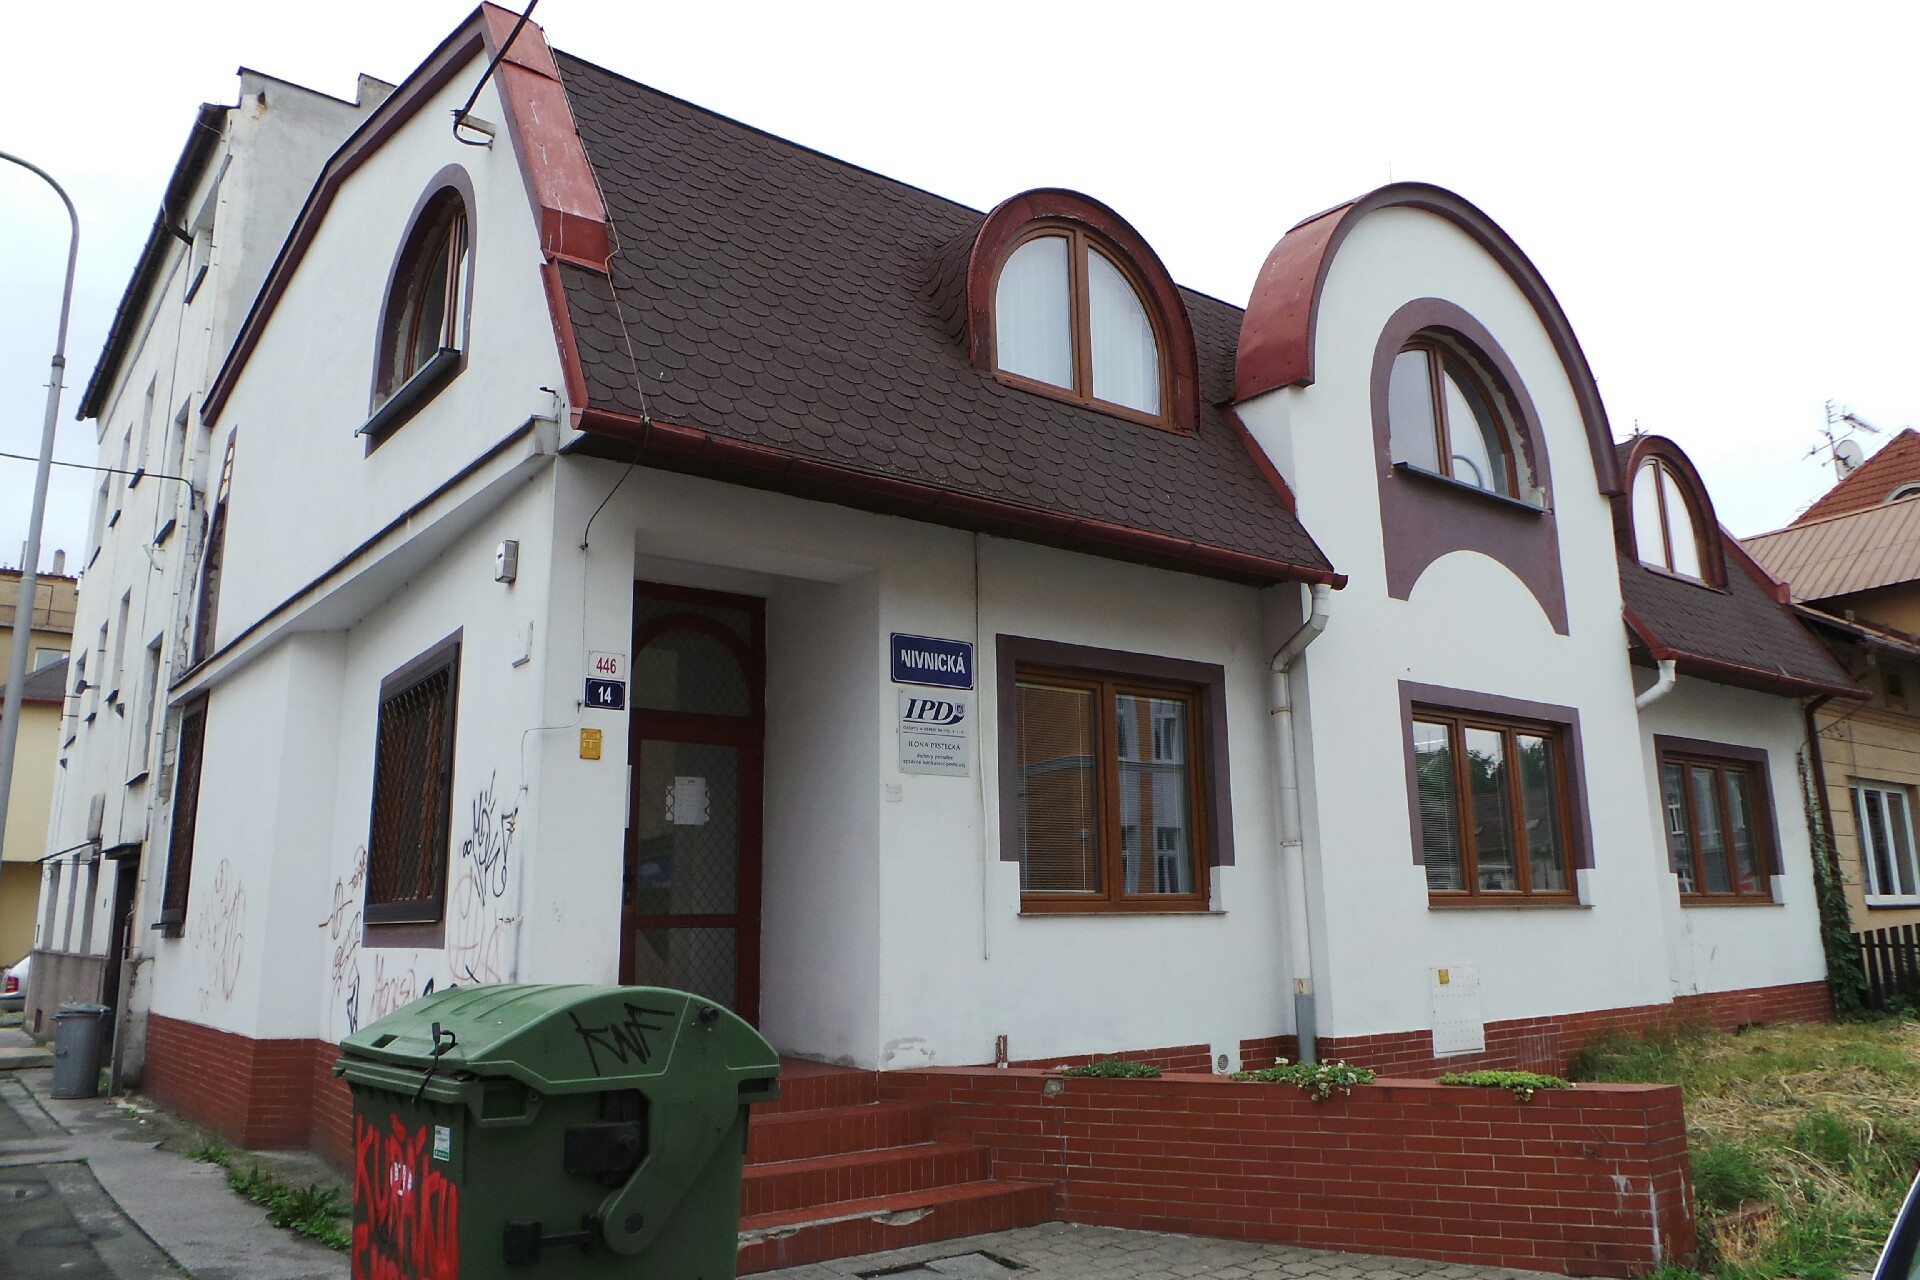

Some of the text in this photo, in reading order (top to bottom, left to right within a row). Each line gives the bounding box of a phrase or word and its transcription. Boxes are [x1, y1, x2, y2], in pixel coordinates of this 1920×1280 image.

[596, 657, 617, 674] 446
[901, 649, 966, 674] NIVNICKÁ
[598, 686, 612, 704] 14
[903, 698, 954, 721] IPD
[908, 740, 929, 748] ILONA
